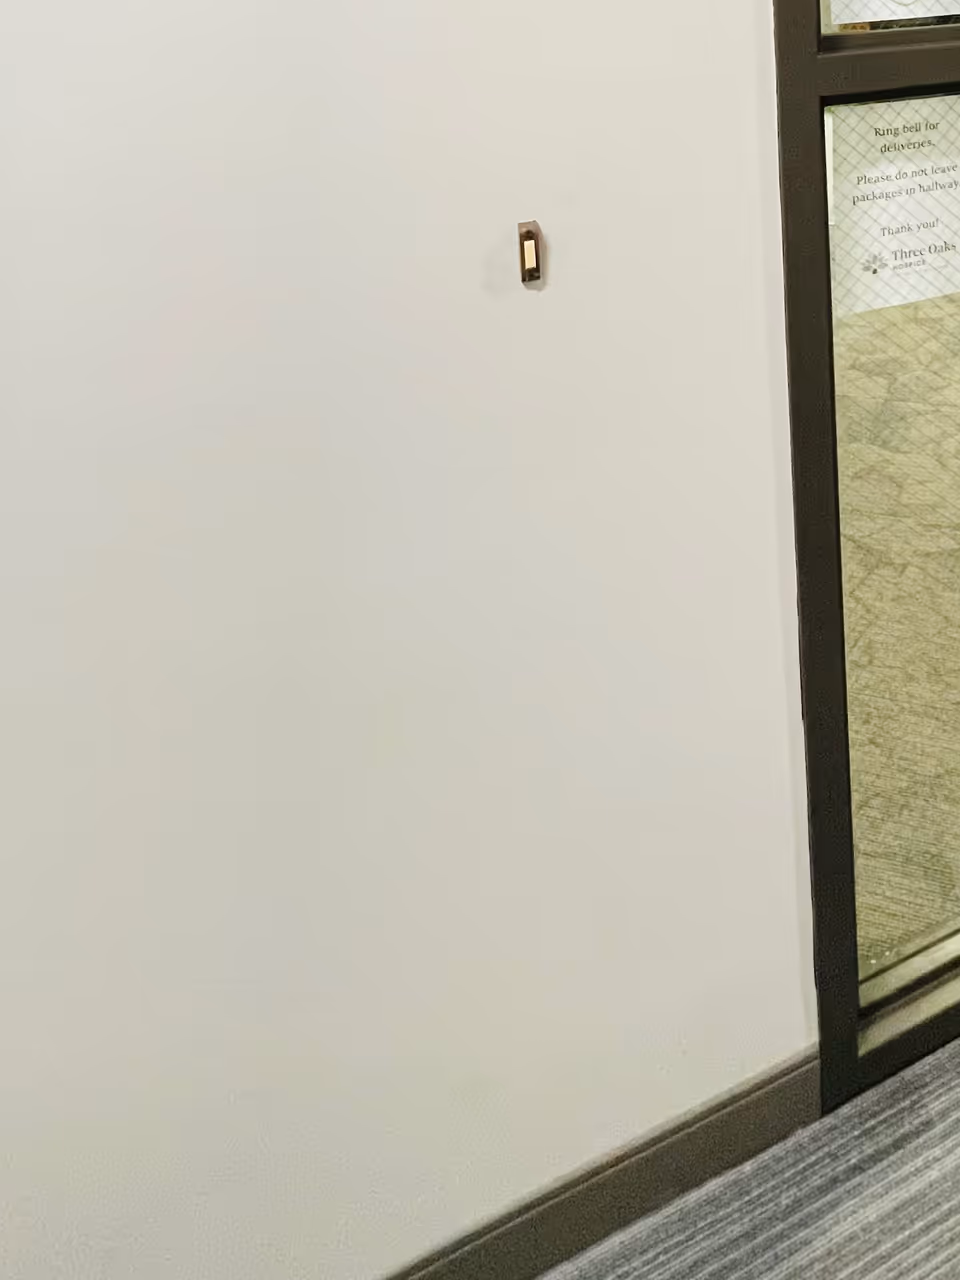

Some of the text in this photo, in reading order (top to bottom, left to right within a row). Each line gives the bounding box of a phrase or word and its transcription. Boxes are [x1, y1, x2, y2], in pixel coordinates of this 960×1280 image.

[874, 121, 940, 137] Ring bell for
[856, 164, 958, 185] Please do not leave
[852, 188, 902, 205] packages
[905, 187, 916, 197] in
[880, 223, 914, 237] Thank
[892, 241, 957, 261] Three Oaks
